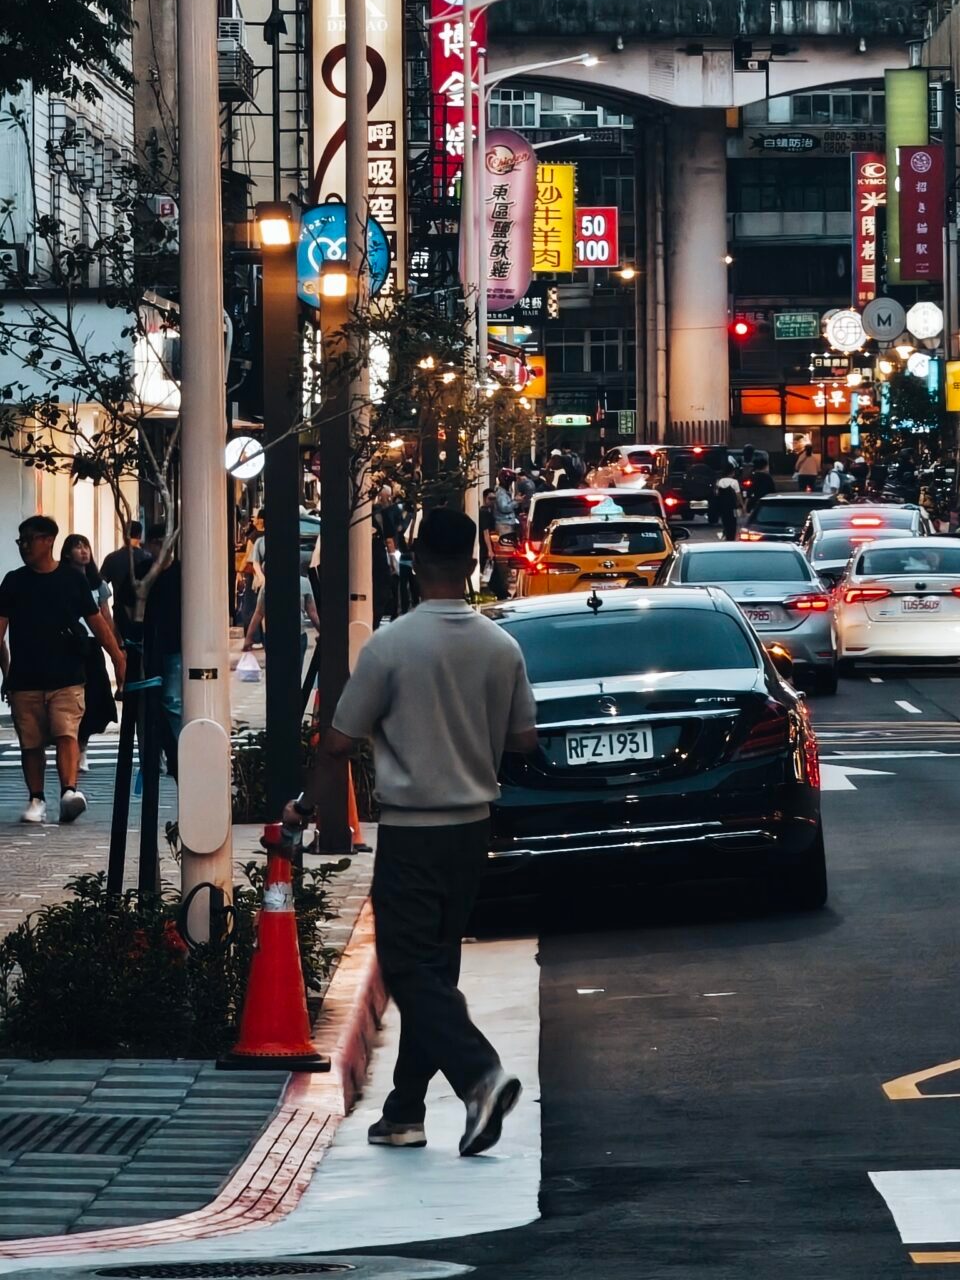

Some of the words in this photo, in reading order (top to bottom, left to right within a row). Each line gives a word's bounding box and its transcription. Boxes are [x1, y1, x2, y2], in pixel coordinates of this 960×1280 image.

[581, 215, 605, 236] 50
[575, 240, 609, 261] 100
[876, 313, 892, 327] M
